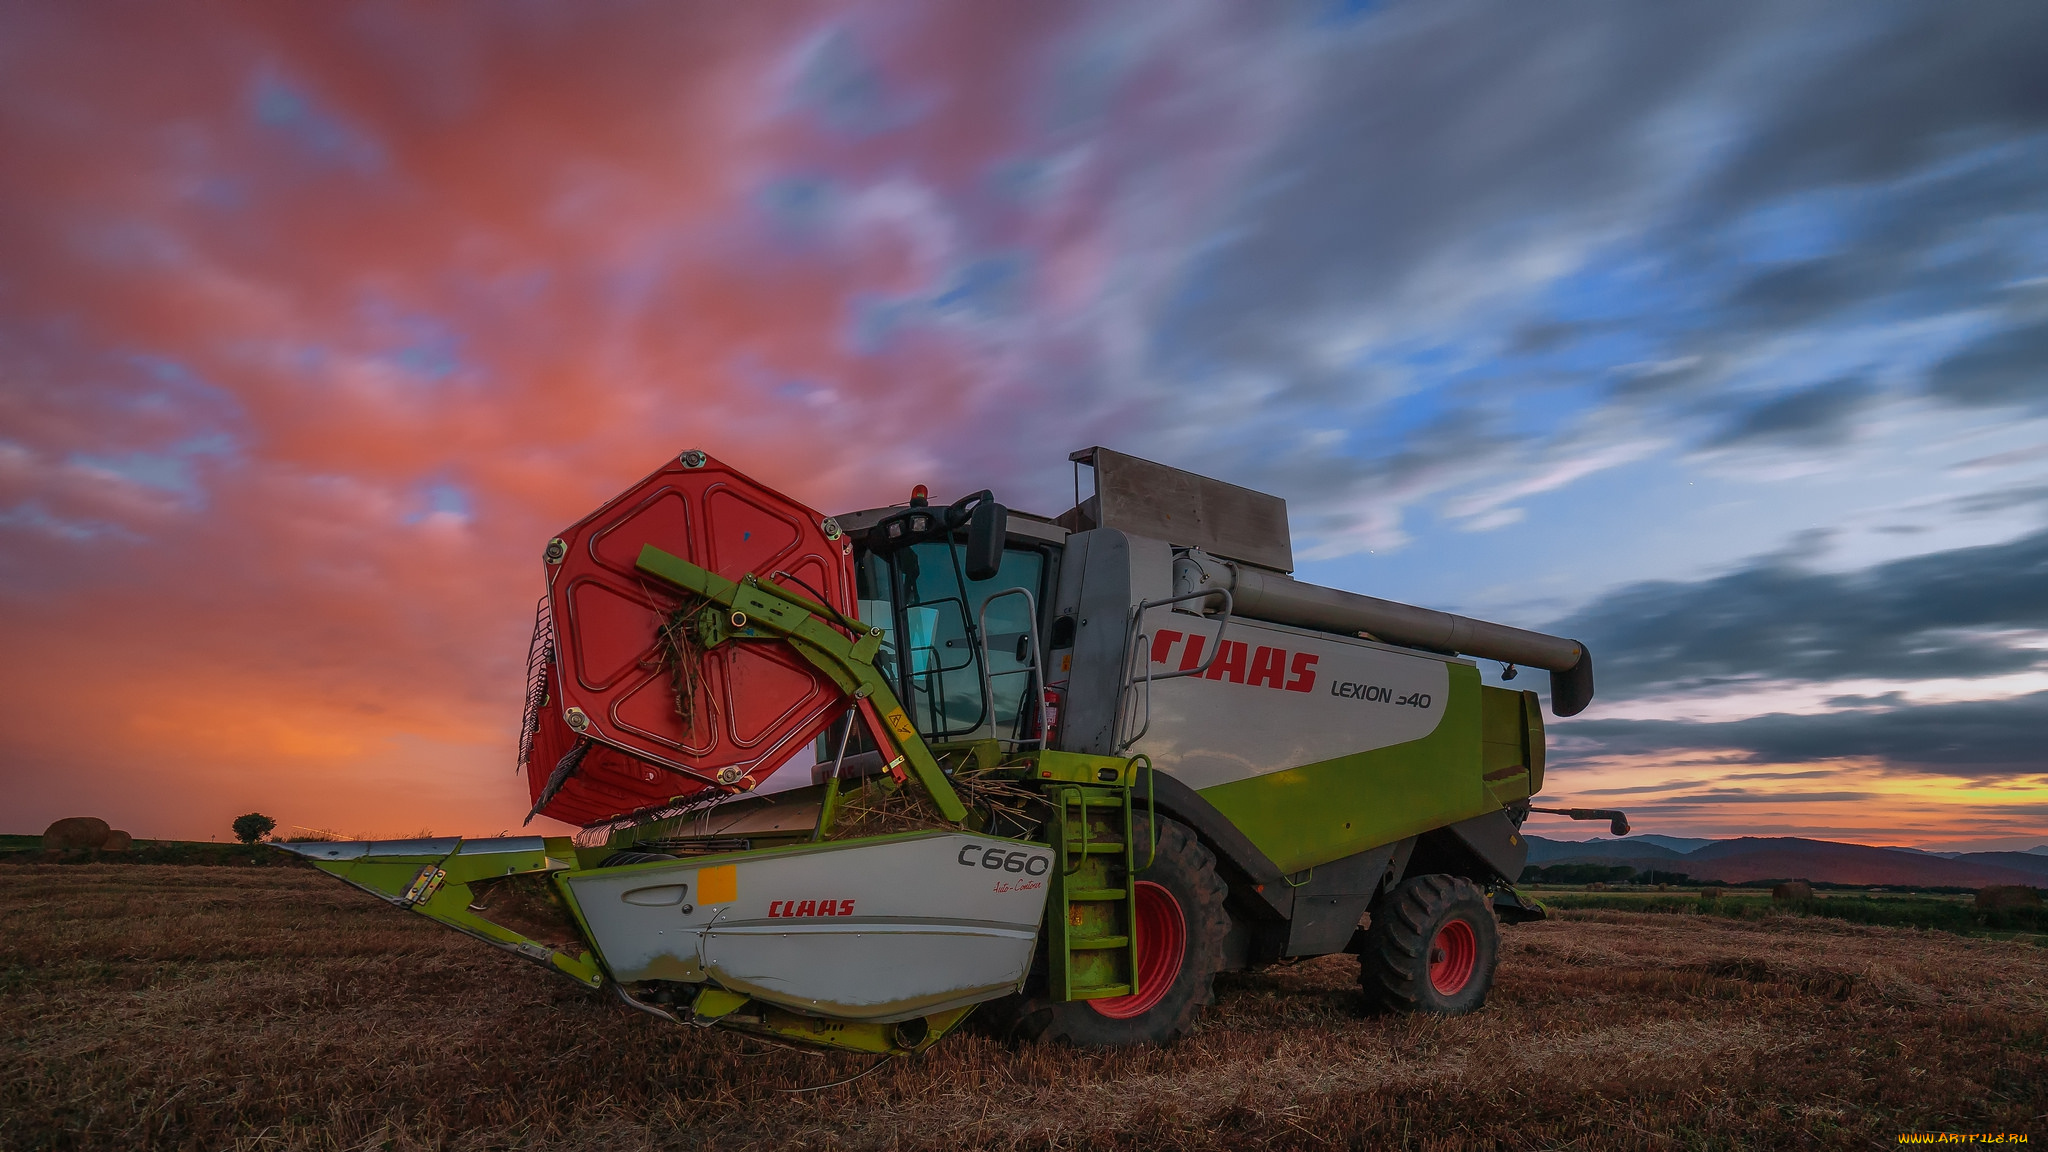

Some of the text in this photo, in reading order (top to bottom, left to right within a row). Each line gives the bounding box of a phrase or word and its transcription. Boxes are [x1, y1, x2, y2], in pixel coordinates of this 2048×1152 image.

[1151, 629, 1320, 693] CLAAS
[1331, 680, 1393, 704] LEXION
[768, 899, 855, 918] CLAAS
